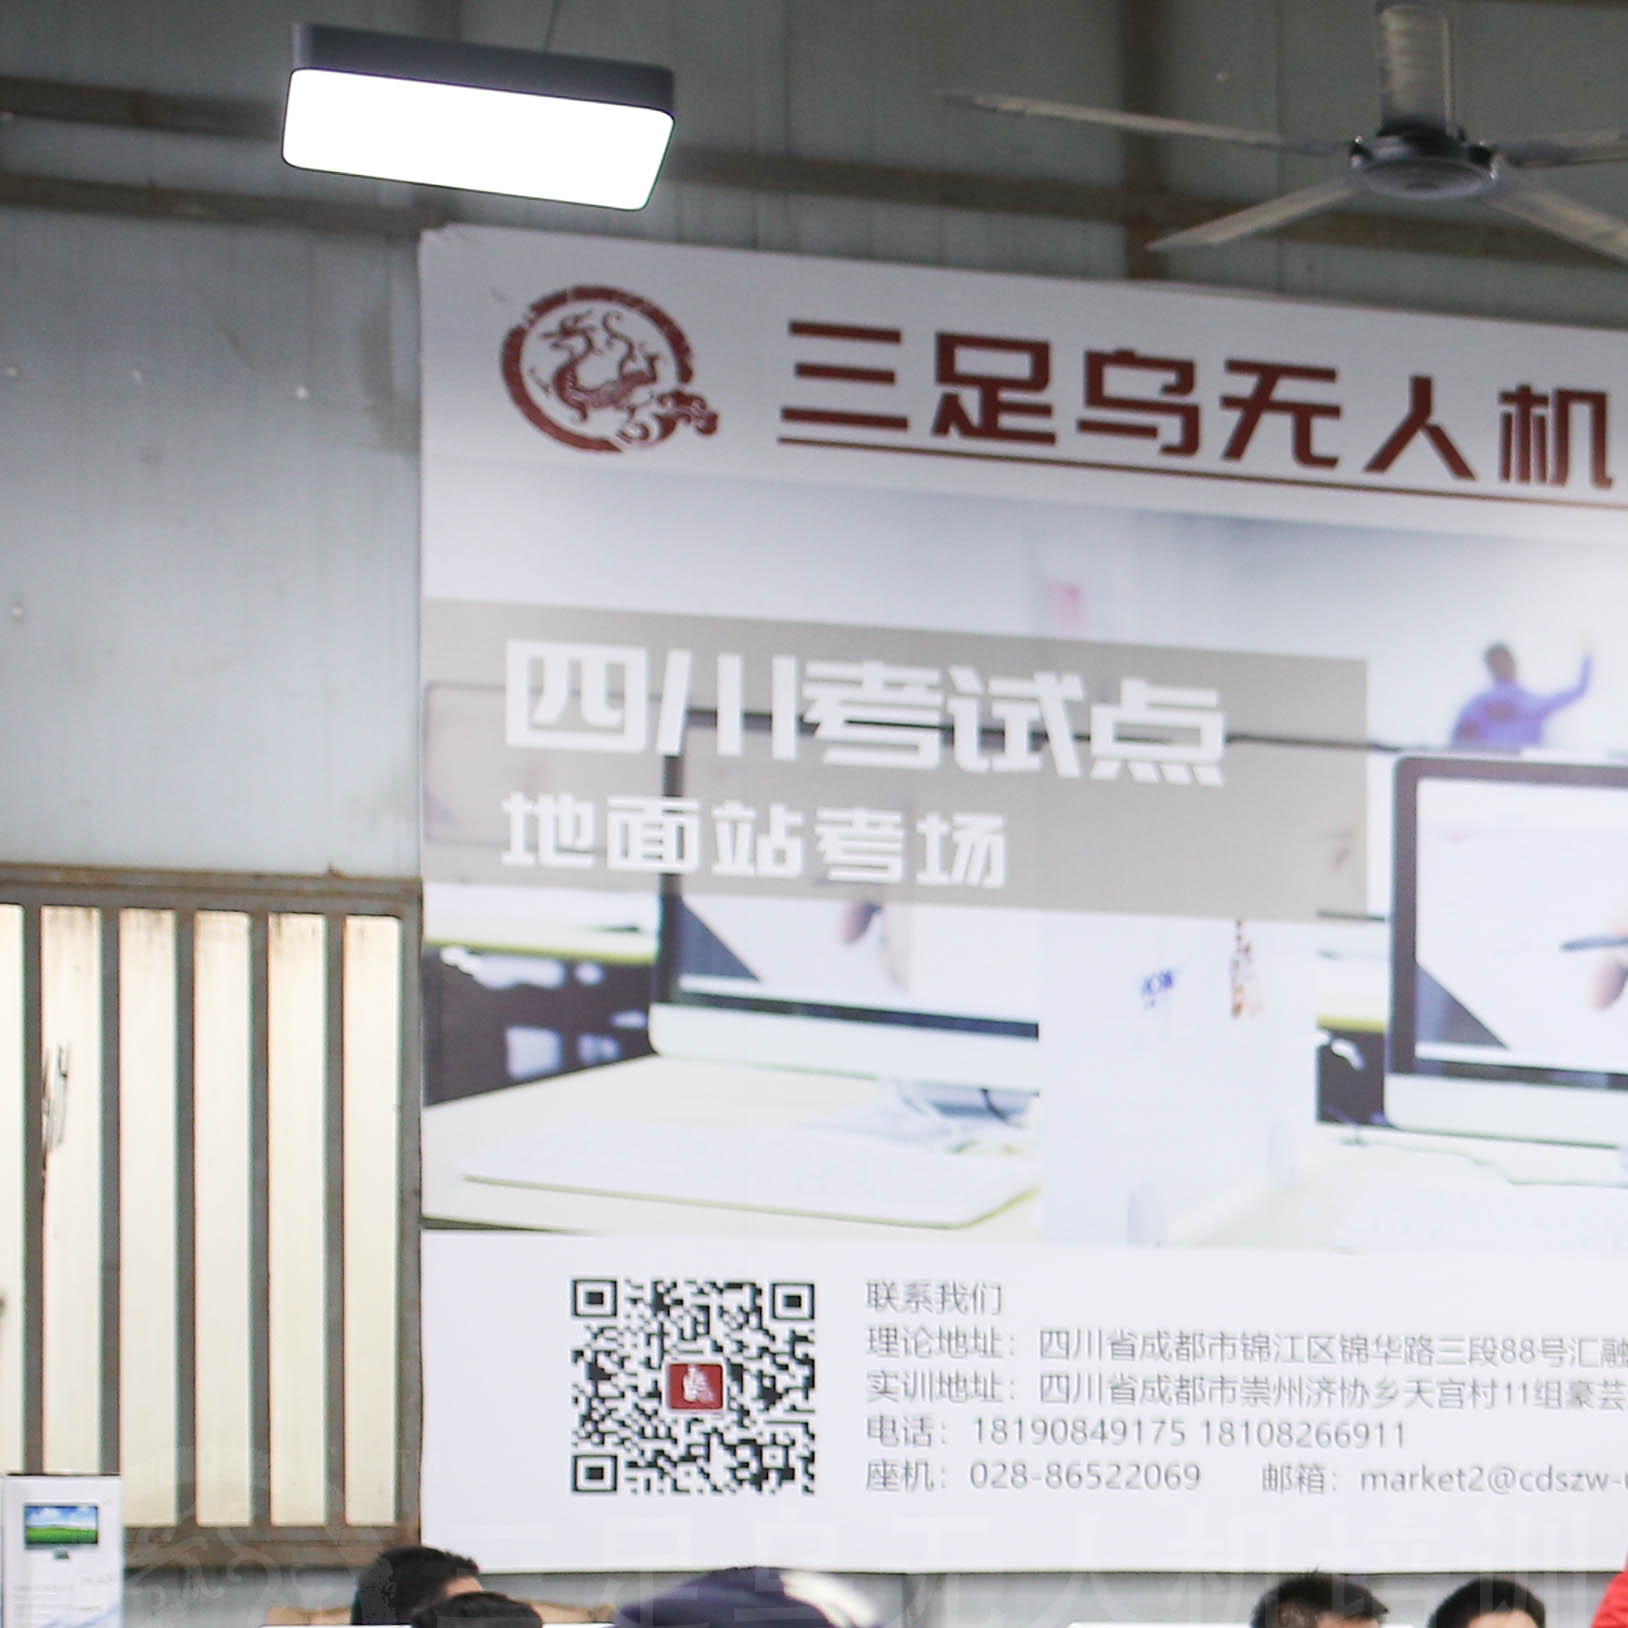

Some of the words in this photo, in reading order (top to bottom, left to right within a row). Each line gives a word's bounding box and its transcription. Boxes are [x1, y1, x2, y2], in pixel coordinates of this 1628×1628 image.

[505, 639, 1225, 787] 四川考试点
[502, 792, 1007, 888] 地面站考场
[865, 1280, 1003, 1316] 联系我们
[973, 1416, 1187, 1446] 18190849175
[1201, 1417, 1406, 1449] 18108266911
[969, 1461, 1201, 1490] 028-86522069
